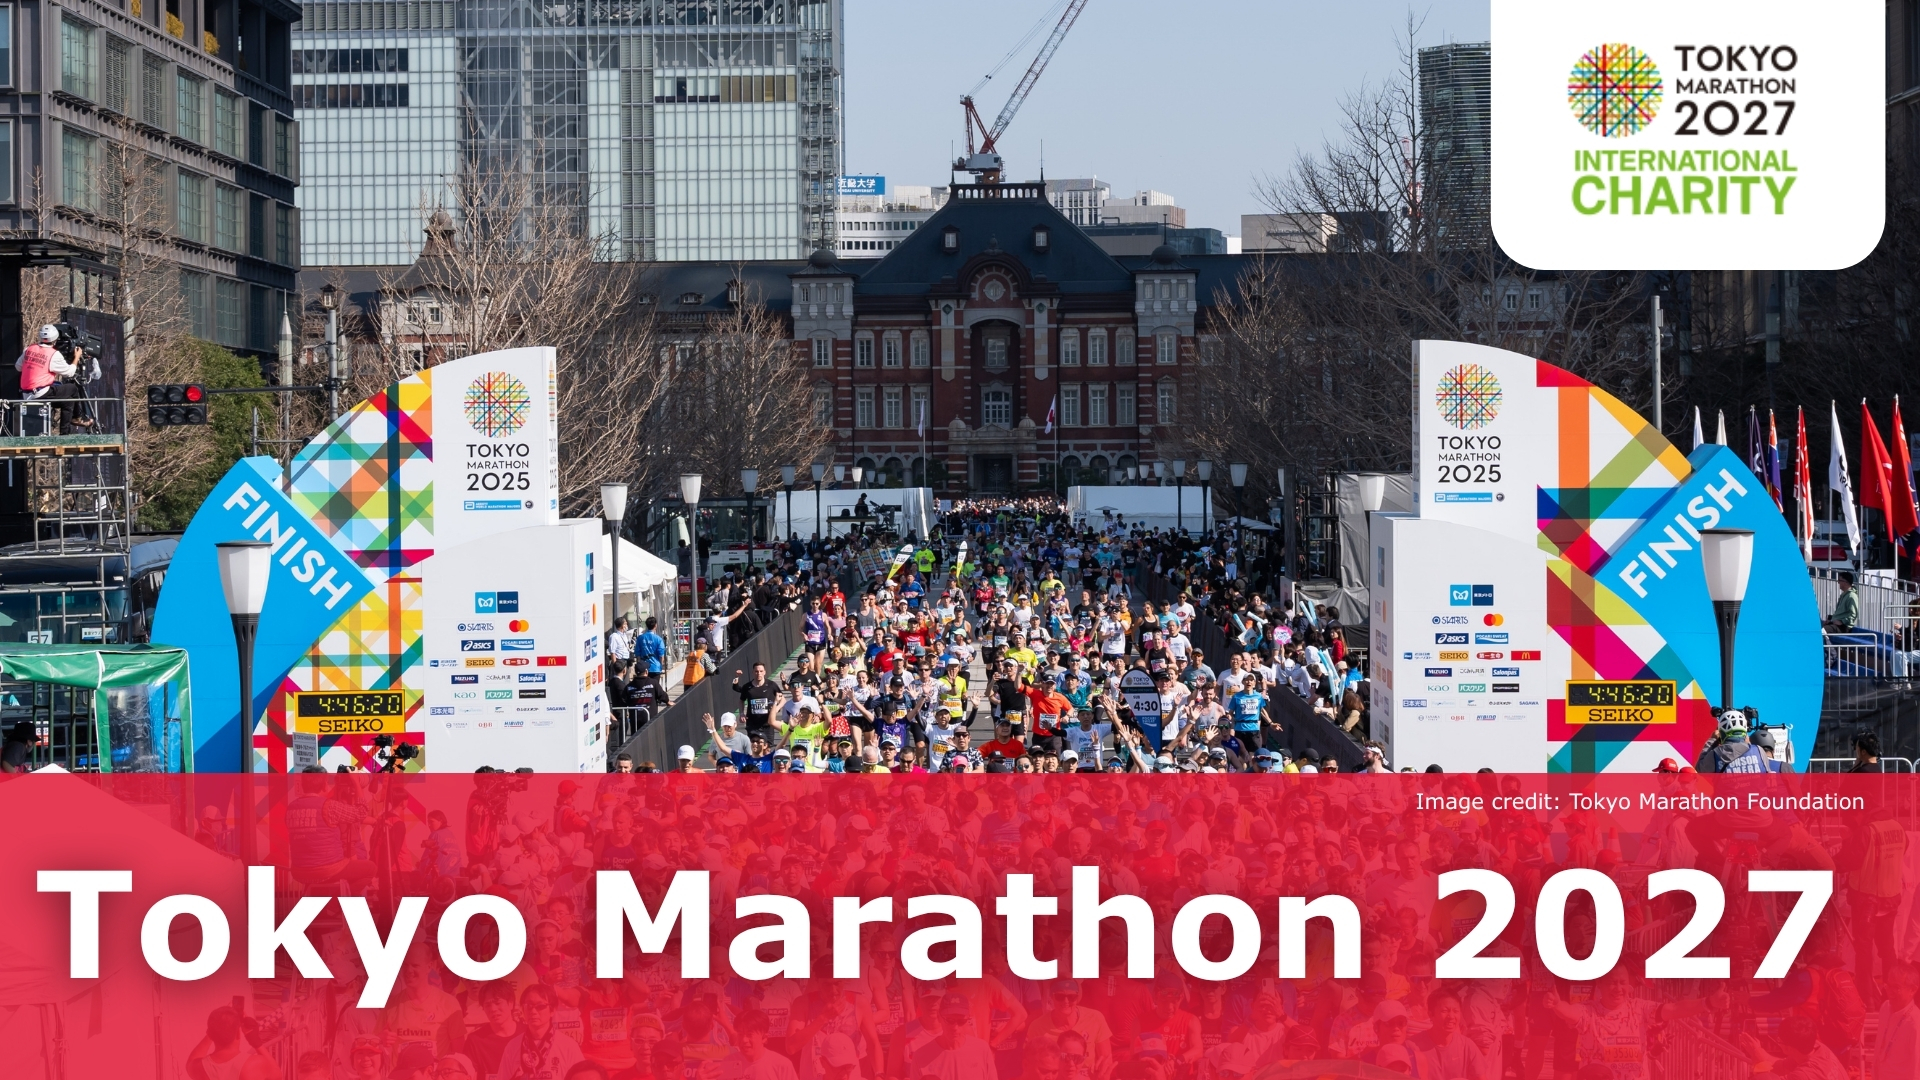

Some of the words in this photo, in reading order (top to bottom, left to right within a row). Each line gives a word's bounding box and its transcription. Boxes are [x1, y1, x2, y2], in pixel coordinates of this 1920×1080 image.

[838, 178, 876, 188] 近畿大学
[1438, 436, 1502, 450] TOKYO
[466, 444, 530, 458] TOKYO
[1438, 453, 1500, 462] MARATHON
[467, 460, 529, 470] MARATHON
[1438, 464, 1502, 482] 2025
[466, 472, 530, 491] 2025
[1618, 468, 1748, 598] FINISH
[222, 482, 352, 610] FINISH
[467, 623, 494, 631] STARTS
[1442, 616, 1468, 624] STARTS
[1589, 686, 1670, 704] 4:46:20
[319, 695, 400, 713] 4:46:20
[1134, 701, 1158, 711] 4:30
[1588, 708, 1654, 722] SEIKO
[318, 719, 384, 732] SEIKO
[1718, 756, 1758, 770] SONSOR
[287, 809, 317, 818] SPONSOR
[397, 1028, 431, 1036] Edwin
